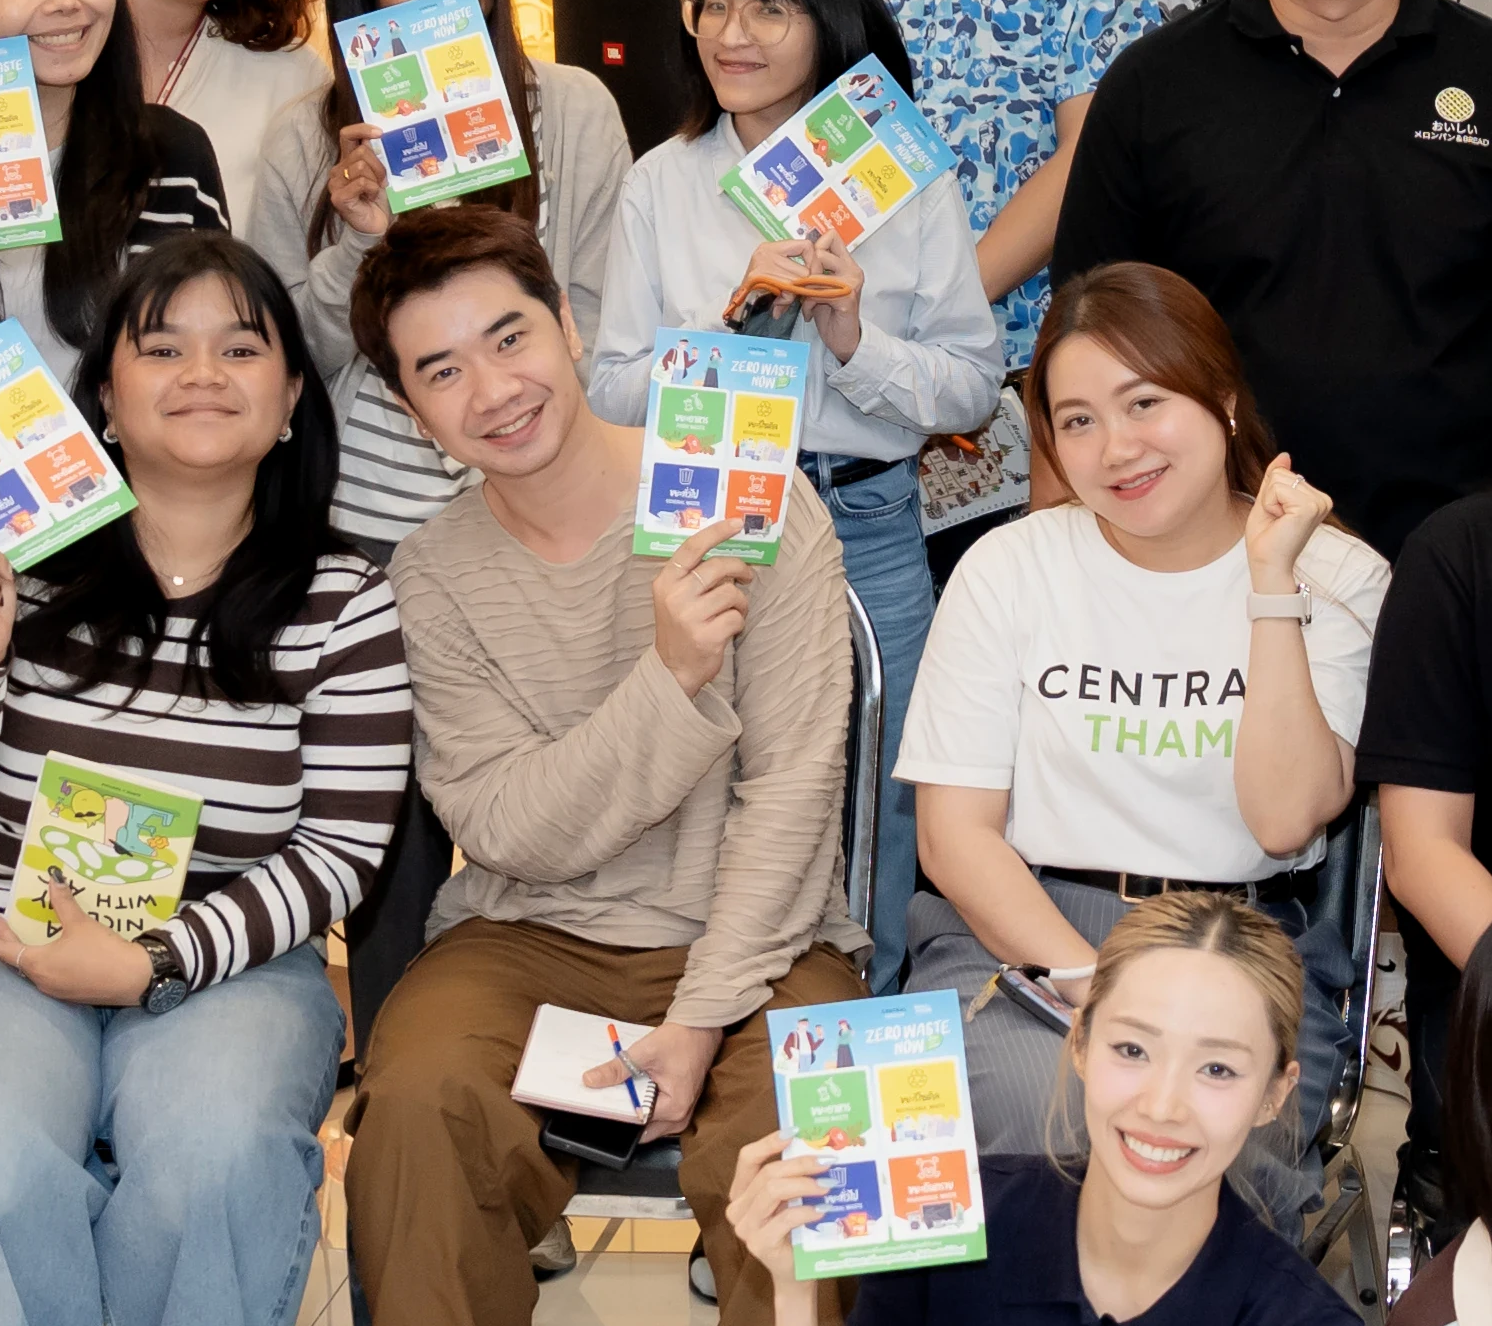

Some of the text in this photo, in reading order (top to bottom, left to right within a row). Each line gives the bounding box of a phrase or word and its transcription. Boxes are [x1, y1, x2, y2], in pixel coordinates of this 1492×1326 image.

[1431, 120, 1478, 135] おいしい
[1084, 713, 1234, 759] THAM
[96, 893, 158, 910] WITH
[864, 1018, 952, 1044] ZERO WASTE
[893, 1037, 925, 1055] NOW
